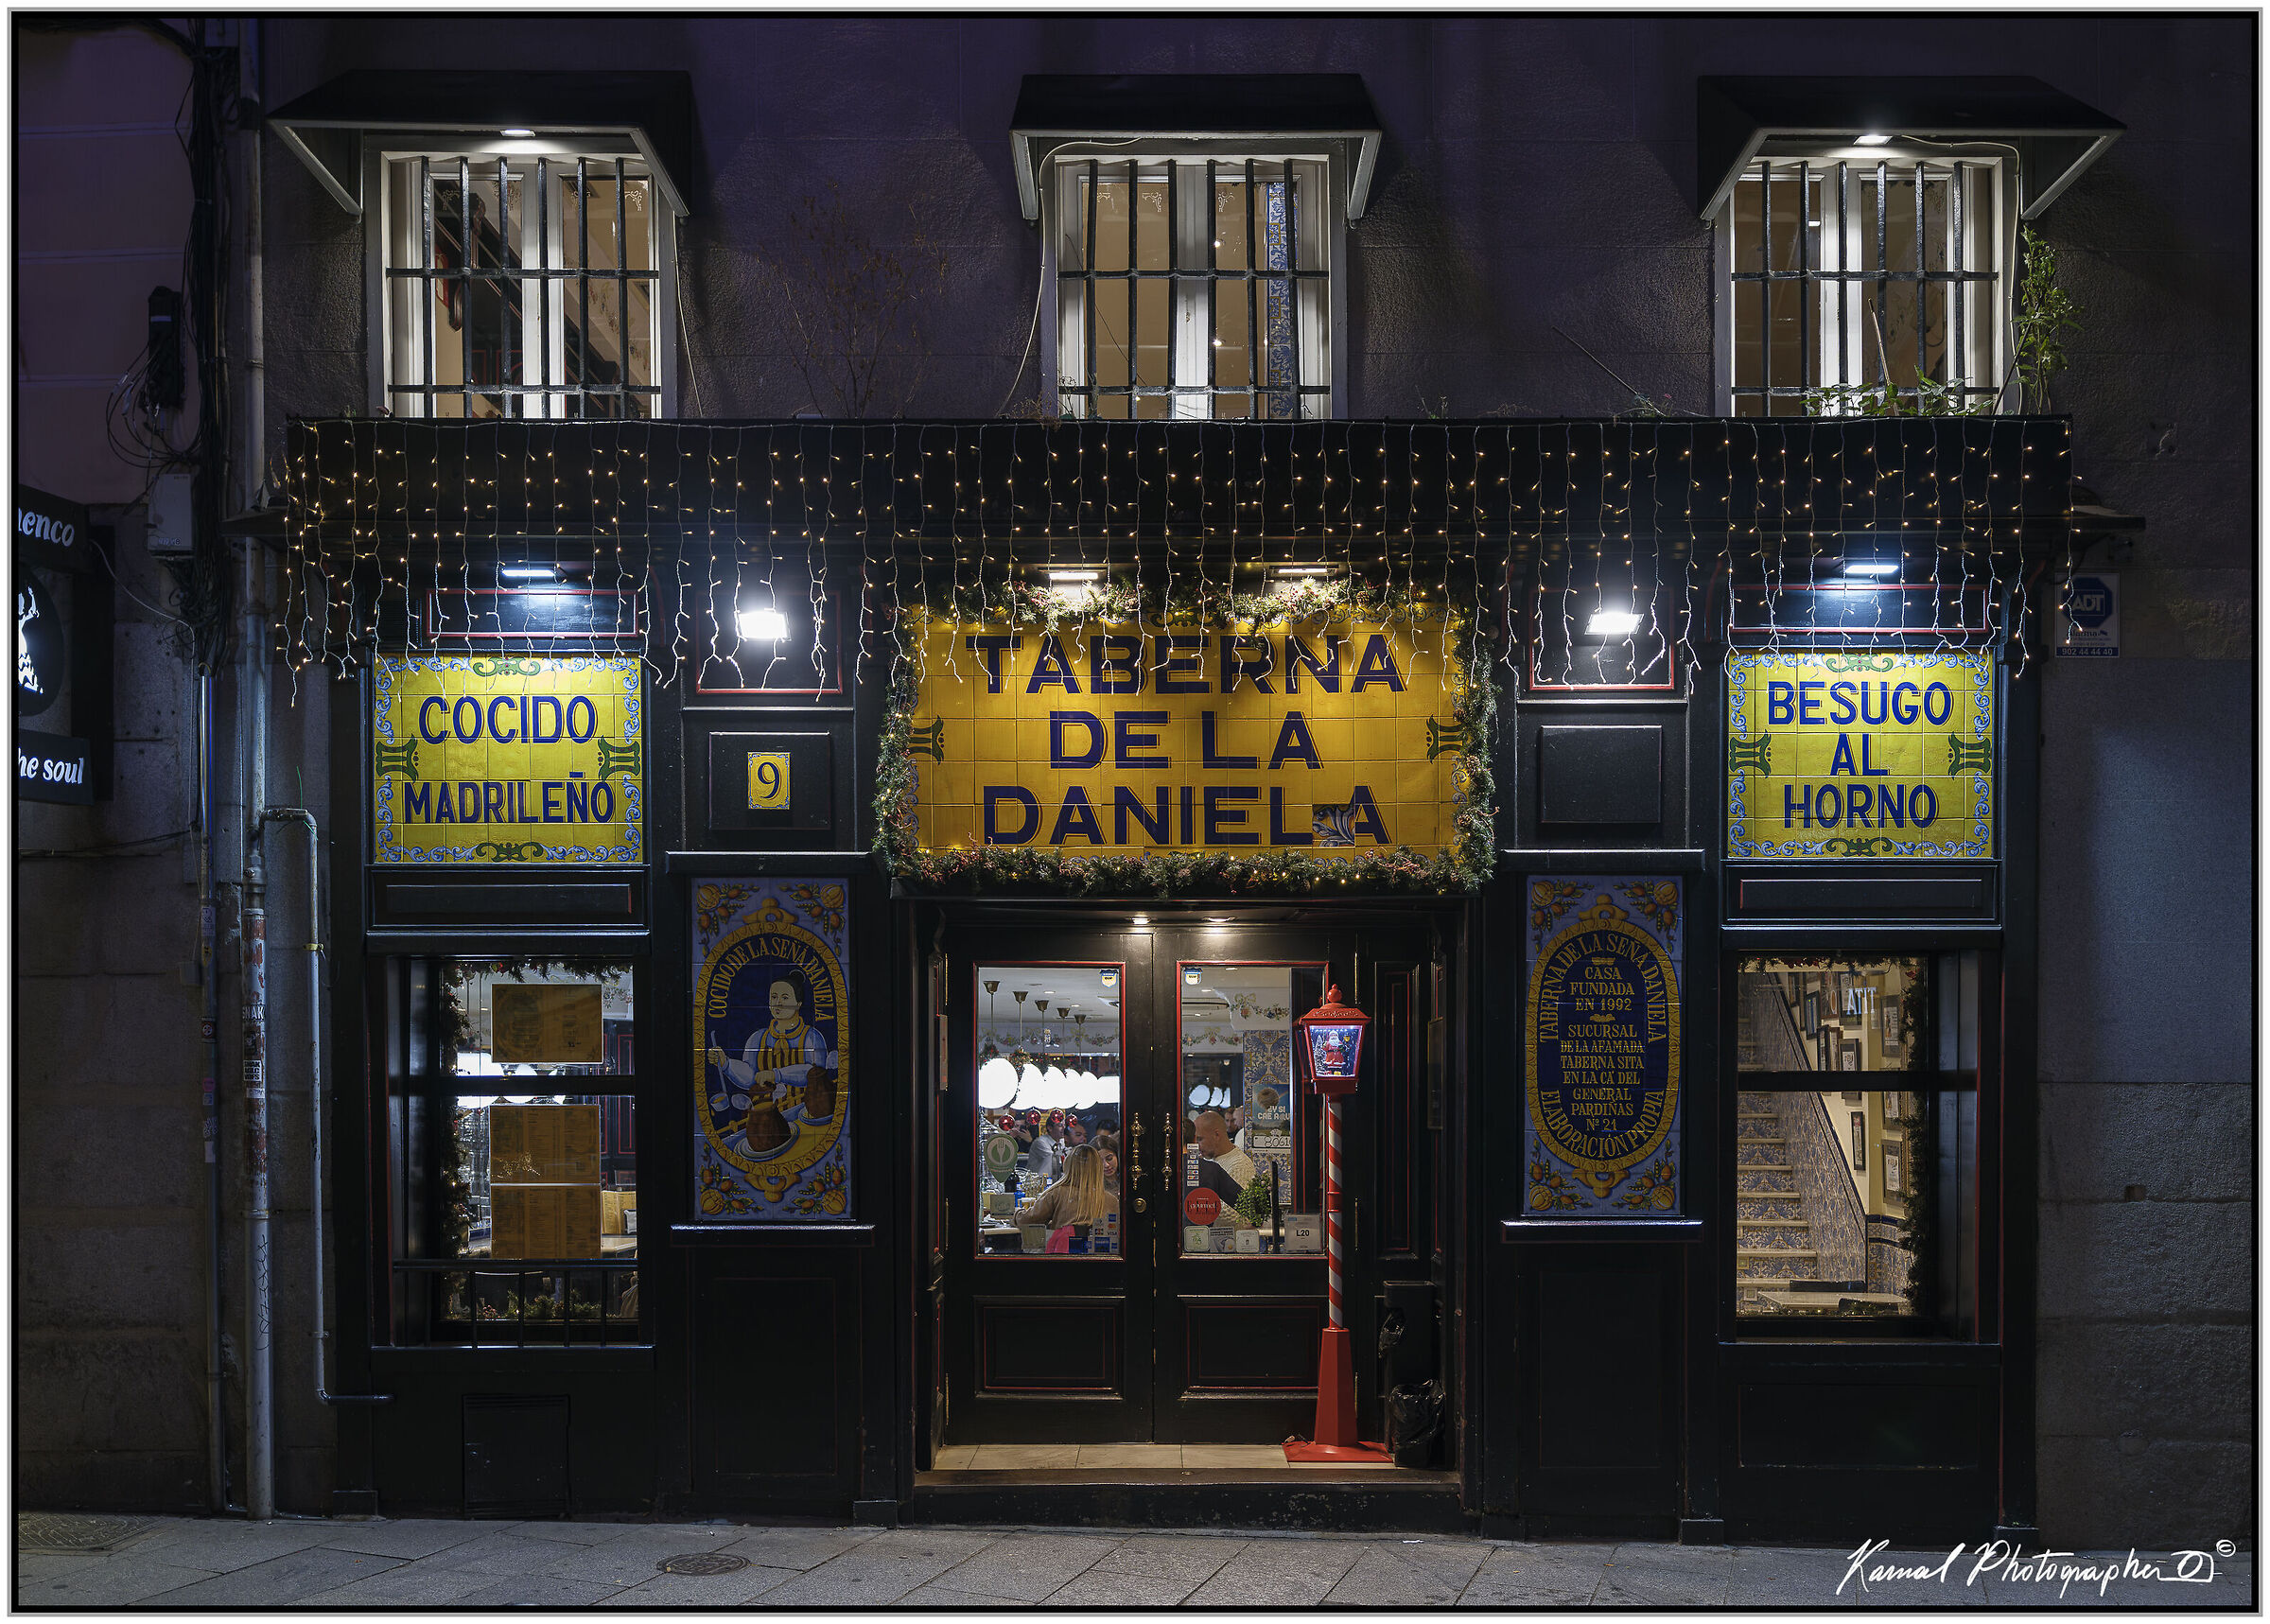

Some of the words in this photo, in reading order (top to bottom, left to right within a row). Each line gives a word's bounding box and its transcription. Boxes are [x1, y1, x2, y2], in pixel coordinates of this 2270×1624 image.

[19, 507, 75, 547] enco
[2072, 594, 2104, 612] ADT
[966, 634, 1407, 695] TABERNA
[419, 695, 599, 745] COCIDO
[1768, 680, 1954, 726] BESUGO
[1049, 710, 1171, 770] DE
[1201, 710, 1324, 770] LA
[1830, 733, 1890, 776] AL
[43, 757, 84, 785] soul
[758, 761, 782, 801] 9
[404, 771, 616, 824] MADRILEÑO
[1784, 783, 1939, 829] HORNO
[983, 785, 1392, 846] DANIELA
[708, 963, 736, 1019] COCIDO
[726, 945, 750, 971] DE
[745, 937, 769, 959] LA
[805, 956, 834, 1022] DANIELA
[1540, 964, 1566, 1043] TABERNA
[1555, 943, 1582, 969] DE
[1578, 933, 1603, 955] LA
[1641, 965, 1667, 1043] DANIELA
[1569, 982, 1635, 996] FUNDADA
[1584, 967, 1623, 980] CASA
[1575, 998, 1595, 1011] EN
[1600, 998, 1633, 1011] 1992
[1561, 1040, 1575, 1053] DE
[1575, 1040, 1590, 1053] LA
[1590, 1040, 1645, 1053] AFAMADA
[1568, 1024, 1637, 1039] SUCURSAL
[1561, 1056, 1615, 1071] TABERNA
[1617, 1056, 1644, 1069] SITA
[1563, 1072, 1580, 1084] EN
[1581, 1072, 1598, 1084] LA
[1617, 1072, 1641, 1084] DEL
[1571, 1102, 1634, 1117] PARDIÑAS
[1573, 1088, 1632, 1102] GENERAL
[1265, 1136, 1291, 1147] 8061
[1541, 1090, 1629, 1159] ELABORACIÓN
[1625, 1090, 1665, 1149] PROPIA
[1603, 1119, 1617, 1131] 21
